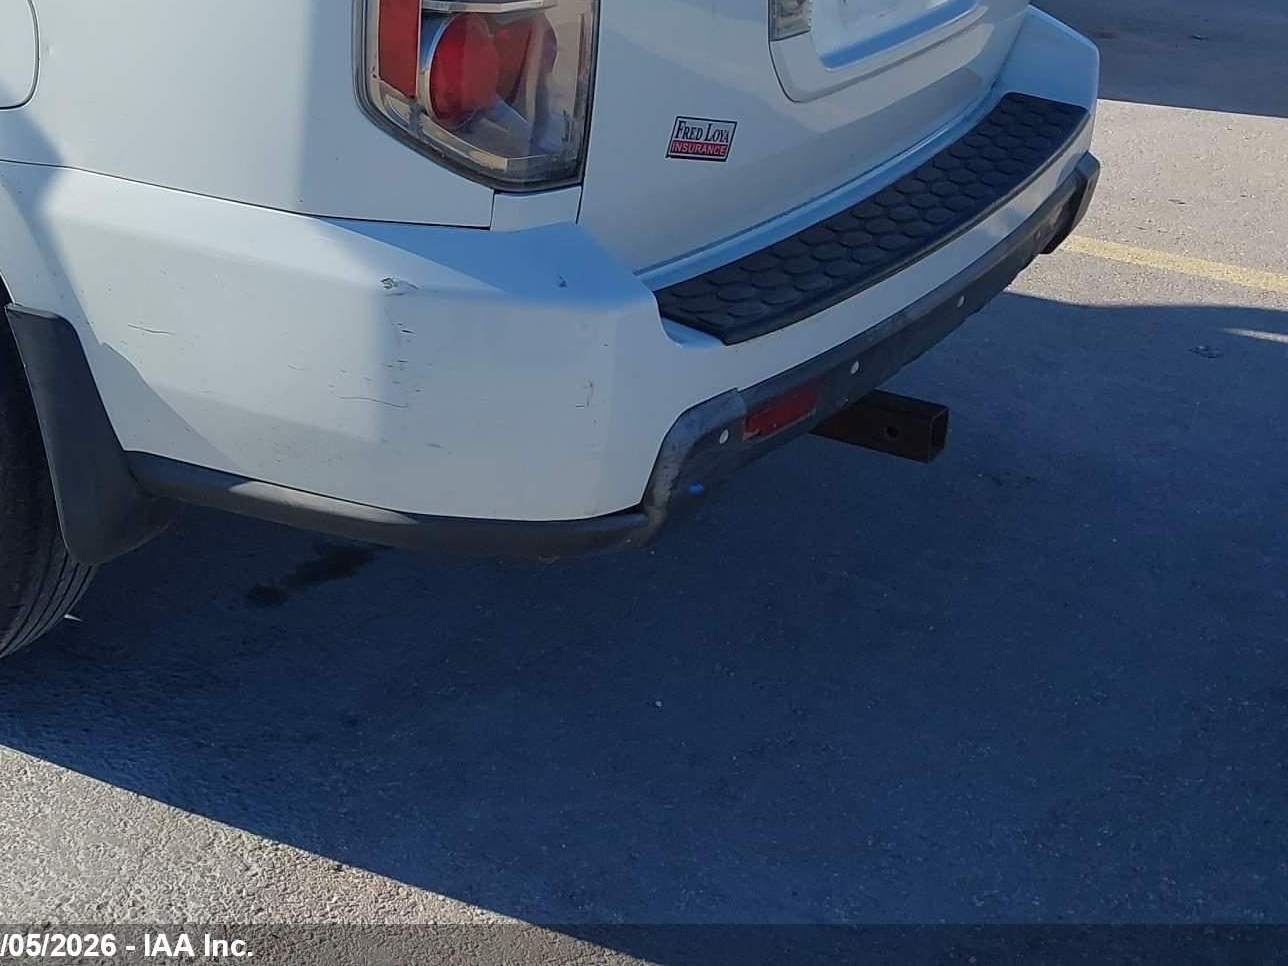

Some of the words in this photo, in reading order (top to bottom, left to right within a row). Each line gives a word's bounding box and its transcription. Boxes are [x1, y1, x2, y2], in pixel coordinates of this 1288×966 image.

[674, 120, 704, 140] FRED
[705, 123, 730, 143] LOYA
[672, 141, 727, 156] INSURANCE
